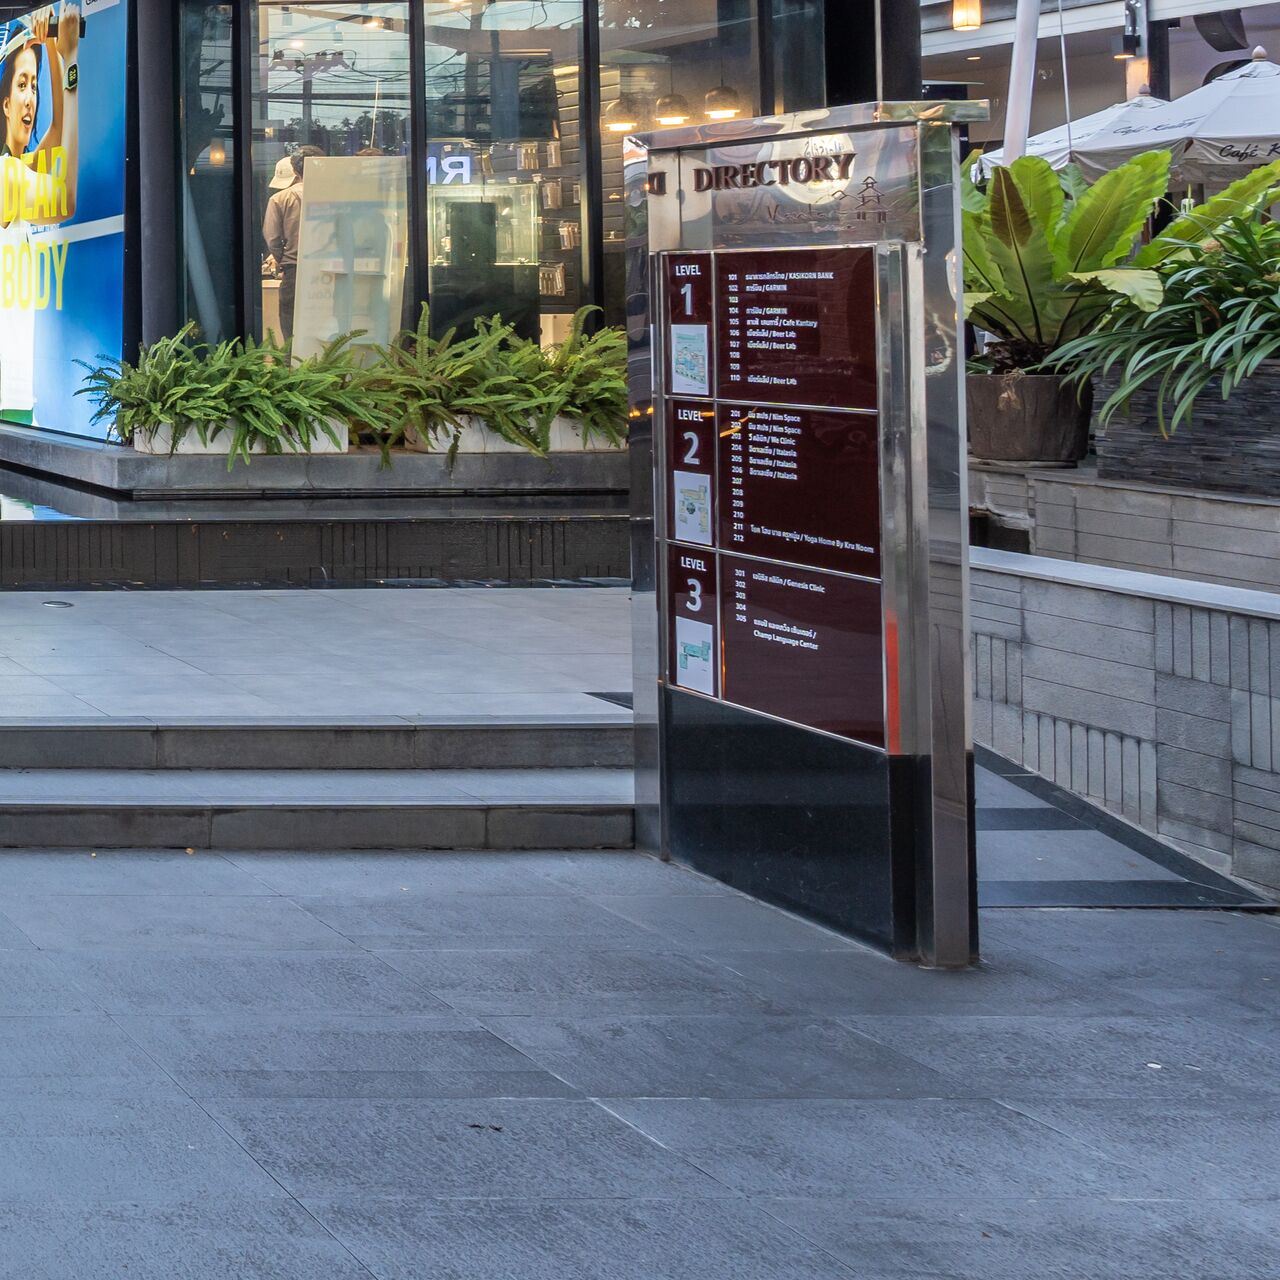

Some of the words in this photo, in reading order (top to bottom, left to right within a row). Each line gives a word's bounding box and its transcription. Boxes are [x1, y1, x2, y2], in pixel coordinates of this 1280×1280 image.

[1219, 144, 1258, 162] Café
[3, 145, 69, 219] DEAR
[693, 153, 857, 192] DIRECTORY
[2, 239, 69, 311] BODY
[676, 264, 701, 276] LEVEL
[681, 283, 693, 316] 1
[678, 409, 703, 422] LEVEL
[683, 431, 701, 465] 2
[734, 534, 744, 542] 212
[681, 556, 706, 571] LEVEL
[686, 578, 702, 612] 3
